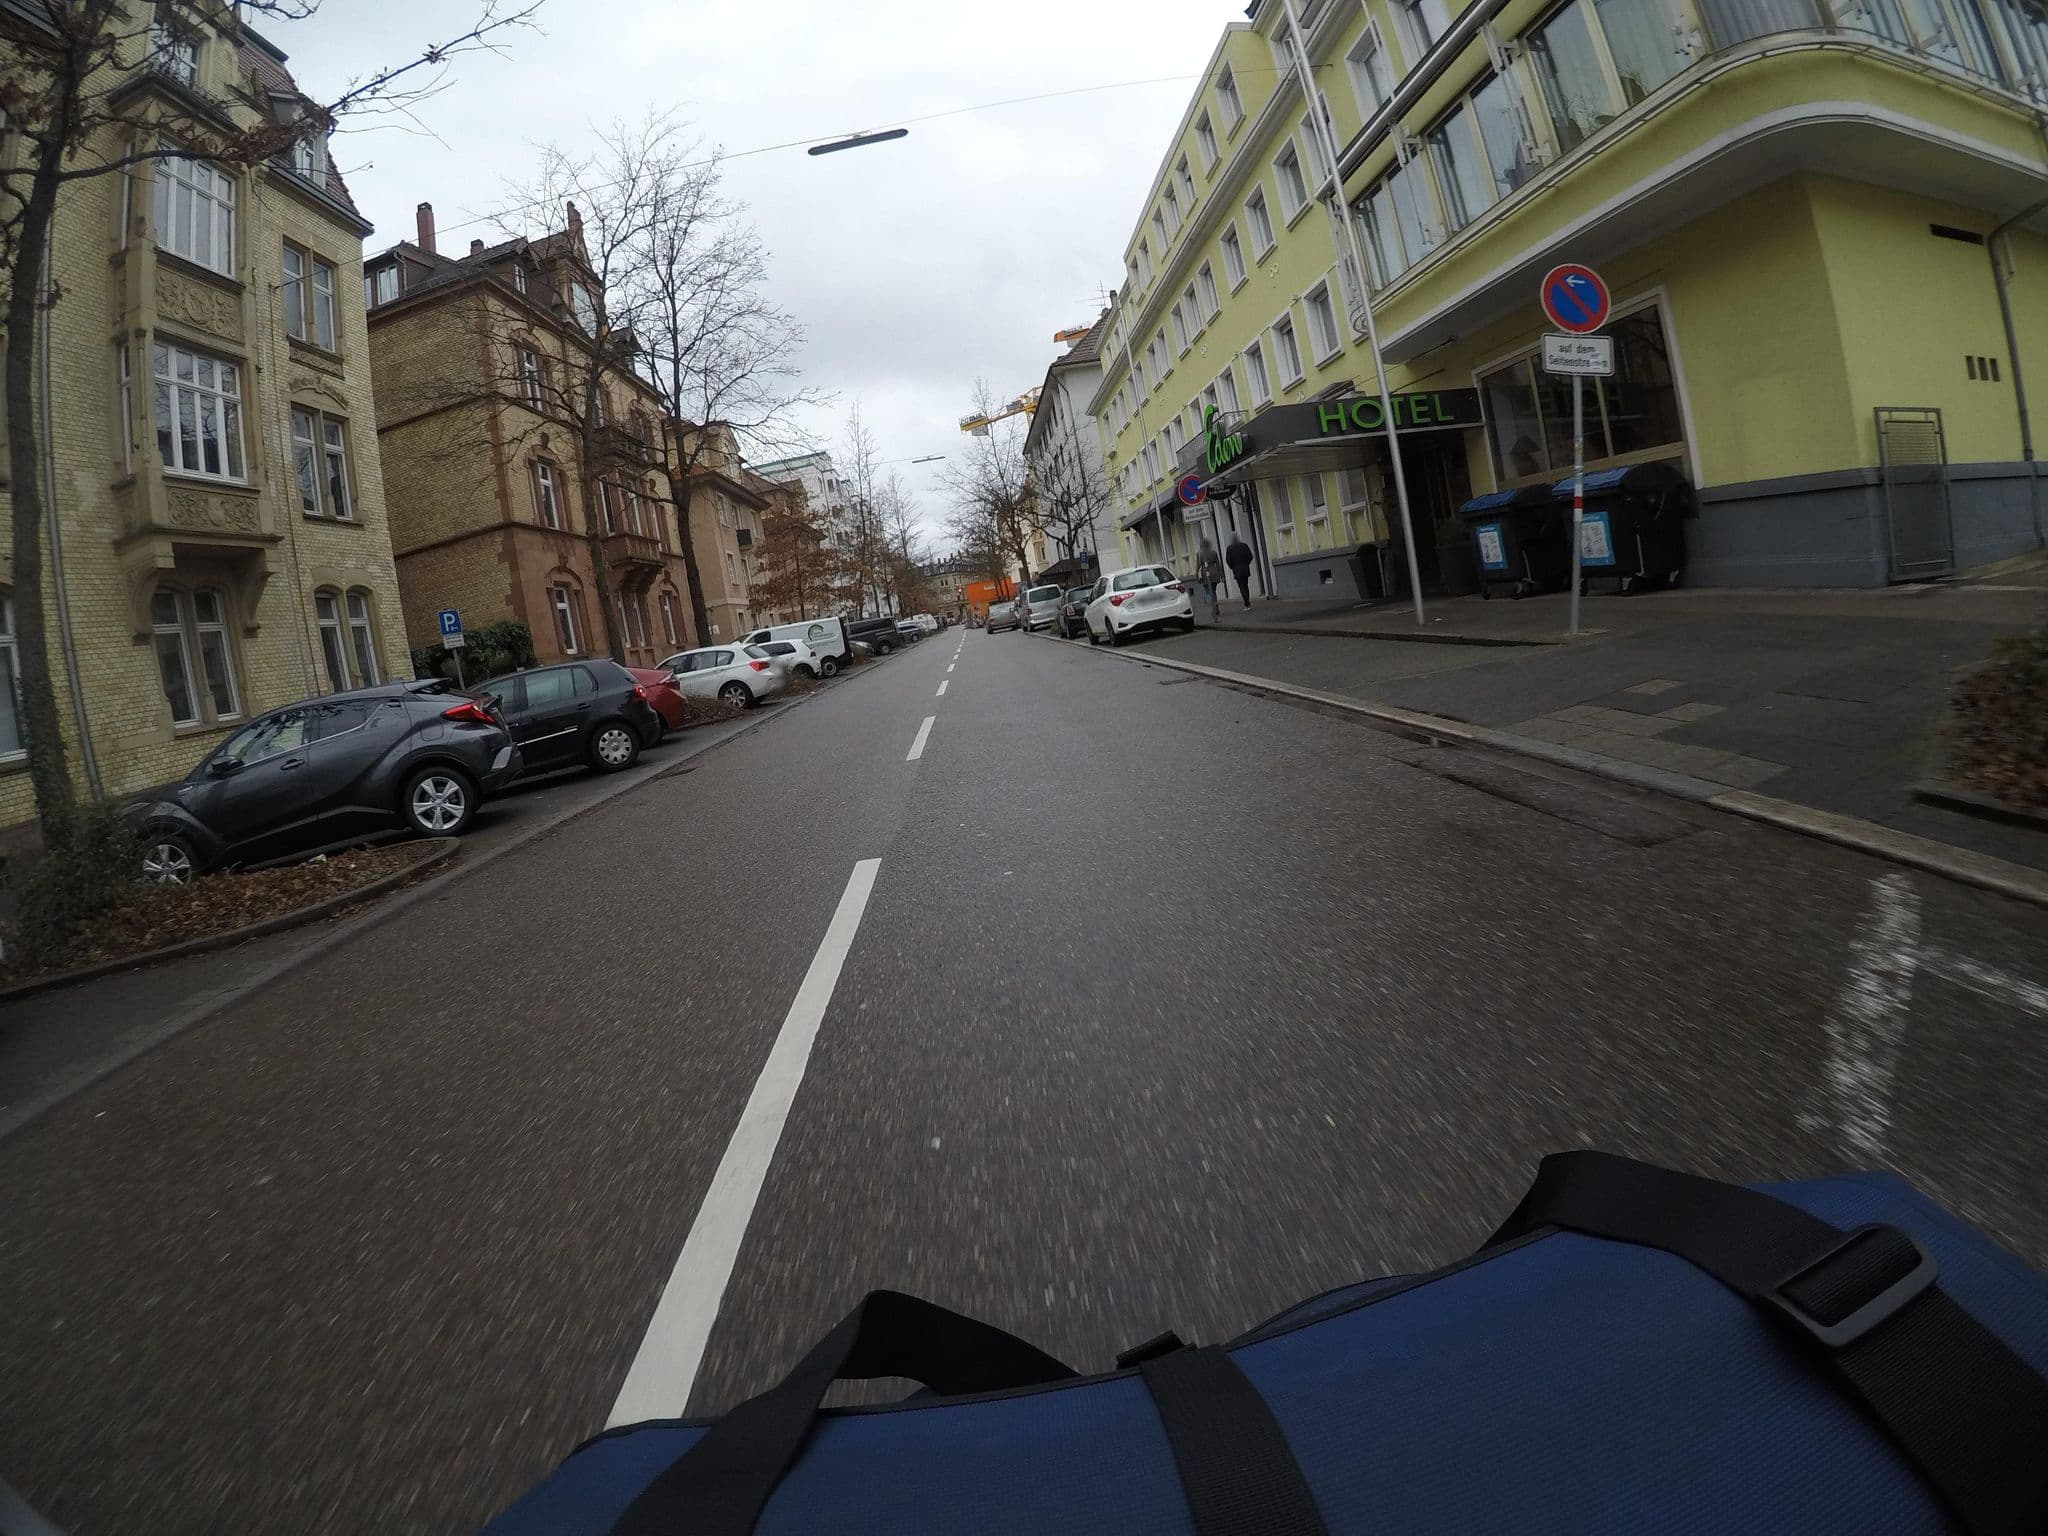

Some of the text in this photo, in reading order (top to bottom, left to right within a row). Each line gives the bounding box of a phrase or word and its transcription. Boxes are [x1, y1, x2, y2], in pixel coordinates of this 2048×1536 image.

[1558, 343, 1596, 354] auf dem
[1548, 354, 1608, 368] Seitenstren
[1318, 394, 1455, 433] HOTEL
[1204, 404, 1243, 474] Eden
[443, 613, 455, 632] P
